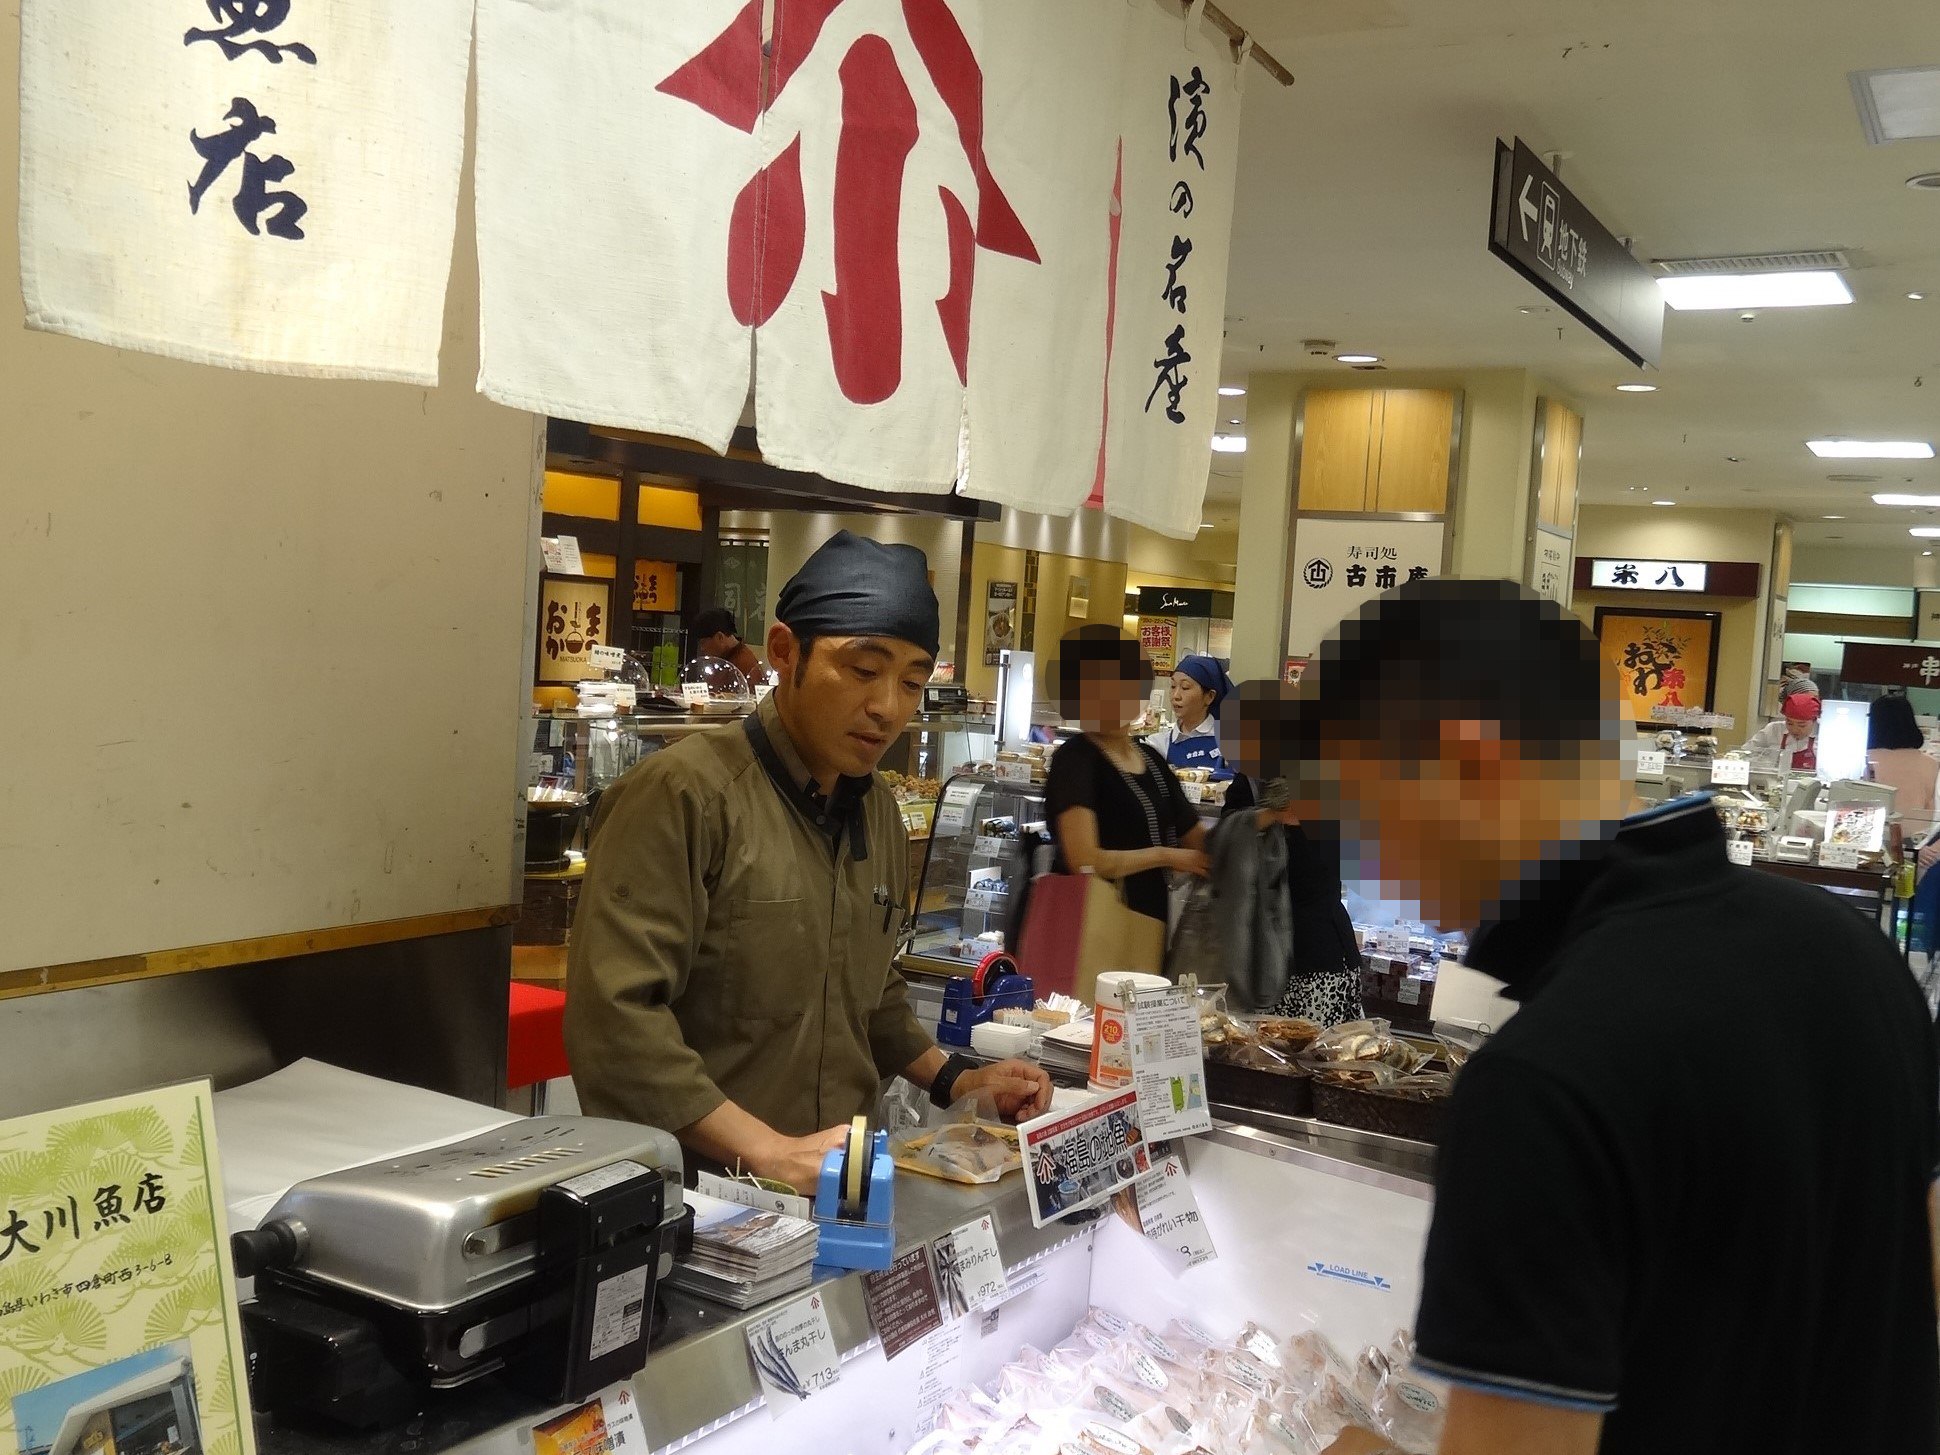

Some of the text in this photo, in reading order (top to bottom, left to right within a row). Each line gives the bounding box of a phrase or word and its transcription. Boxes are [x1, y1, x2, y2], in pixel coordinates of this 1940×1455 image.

[1559, 219, 1587, 278] 地下鉄
[1556, 258, 1574, 289] Subway
[1347, 545, 1398, 561] 寿司処
[1141, 625, 1172, 637] お客様
[1142, 637, 1172, 648] 感謝祭
[559, 655, 587, 664] MATSUOKA
[1103, 1024, 1118, 1034] 210
[1062, 1120, 1128, 1176] 福島の地魚
[0, 1172, 167, 1261] 大川魚店
[1329, 1264, 1369, 1279] LOAD LINE
[0, 1253, 173, 1317] 島県いわき市四倉町西3-6-8
[778, 1329, 826, 1361] さんま丸干し
